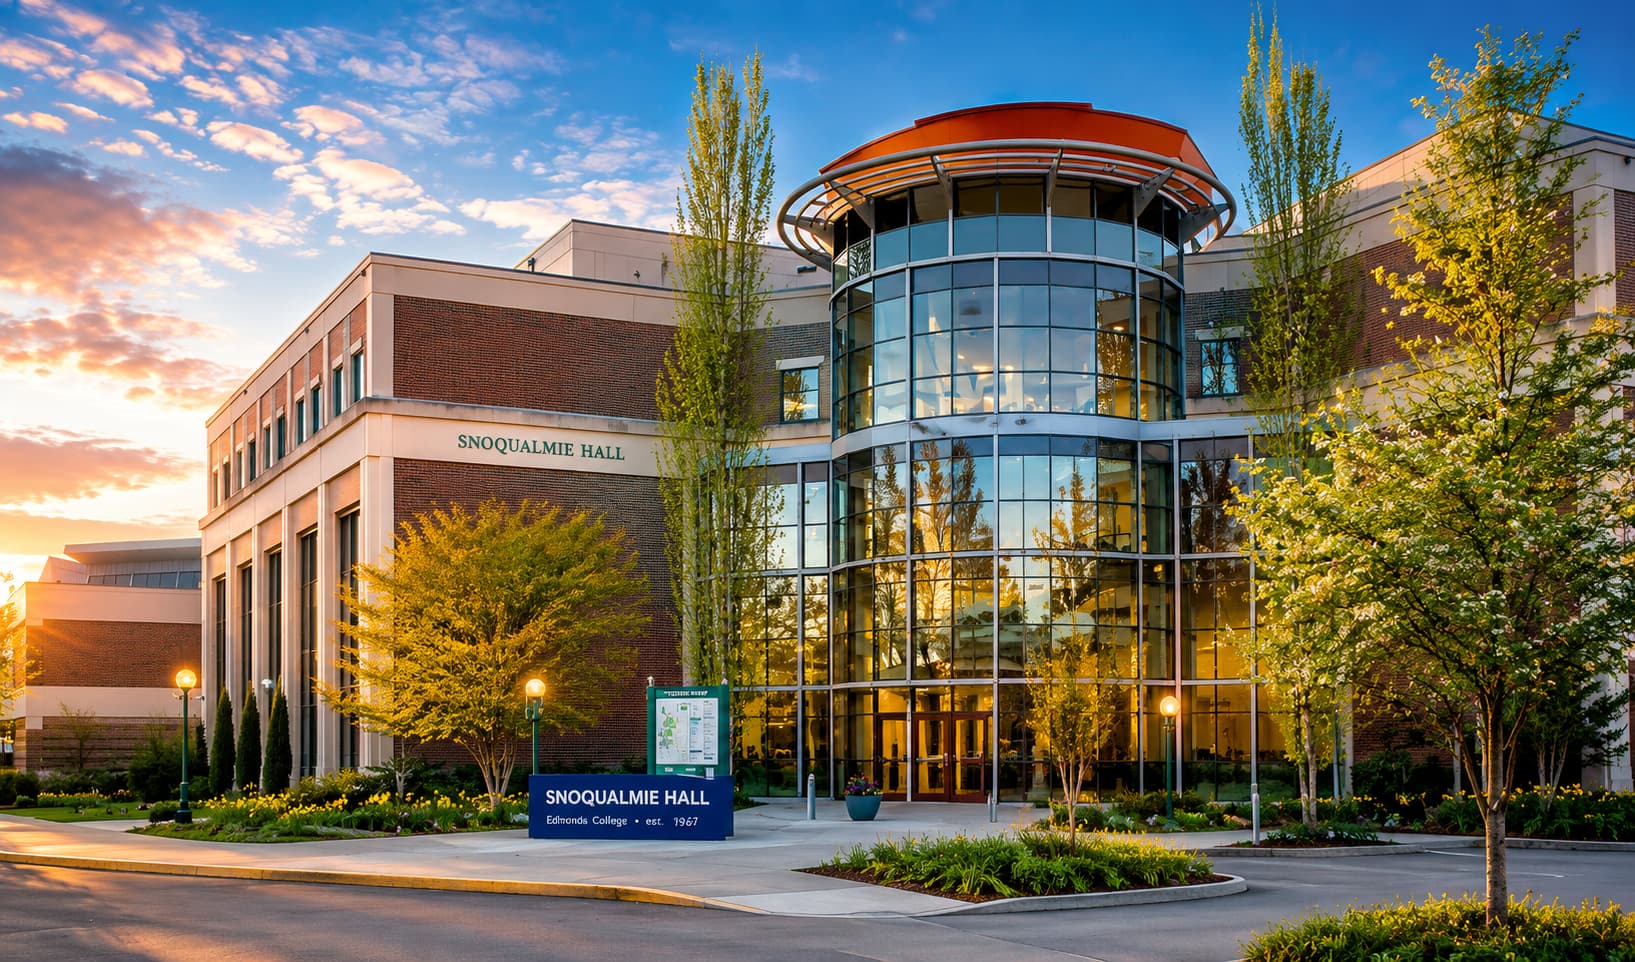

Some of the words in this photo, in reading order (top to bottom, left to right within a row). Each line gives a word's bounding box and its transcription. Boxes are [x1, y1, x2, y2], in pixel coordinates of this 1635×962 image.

[458, 434, 575, 457] SNOQUALMIE
[580, 443, 625, 461] HALL
[545, 789, 660, 807] SNOQUALMIE
[664, 790, 710, 806] HALL
[592, 815, 628, 828] College
[645, 817, 665, 827] est.
[673, 816, 699, 827] 1967
